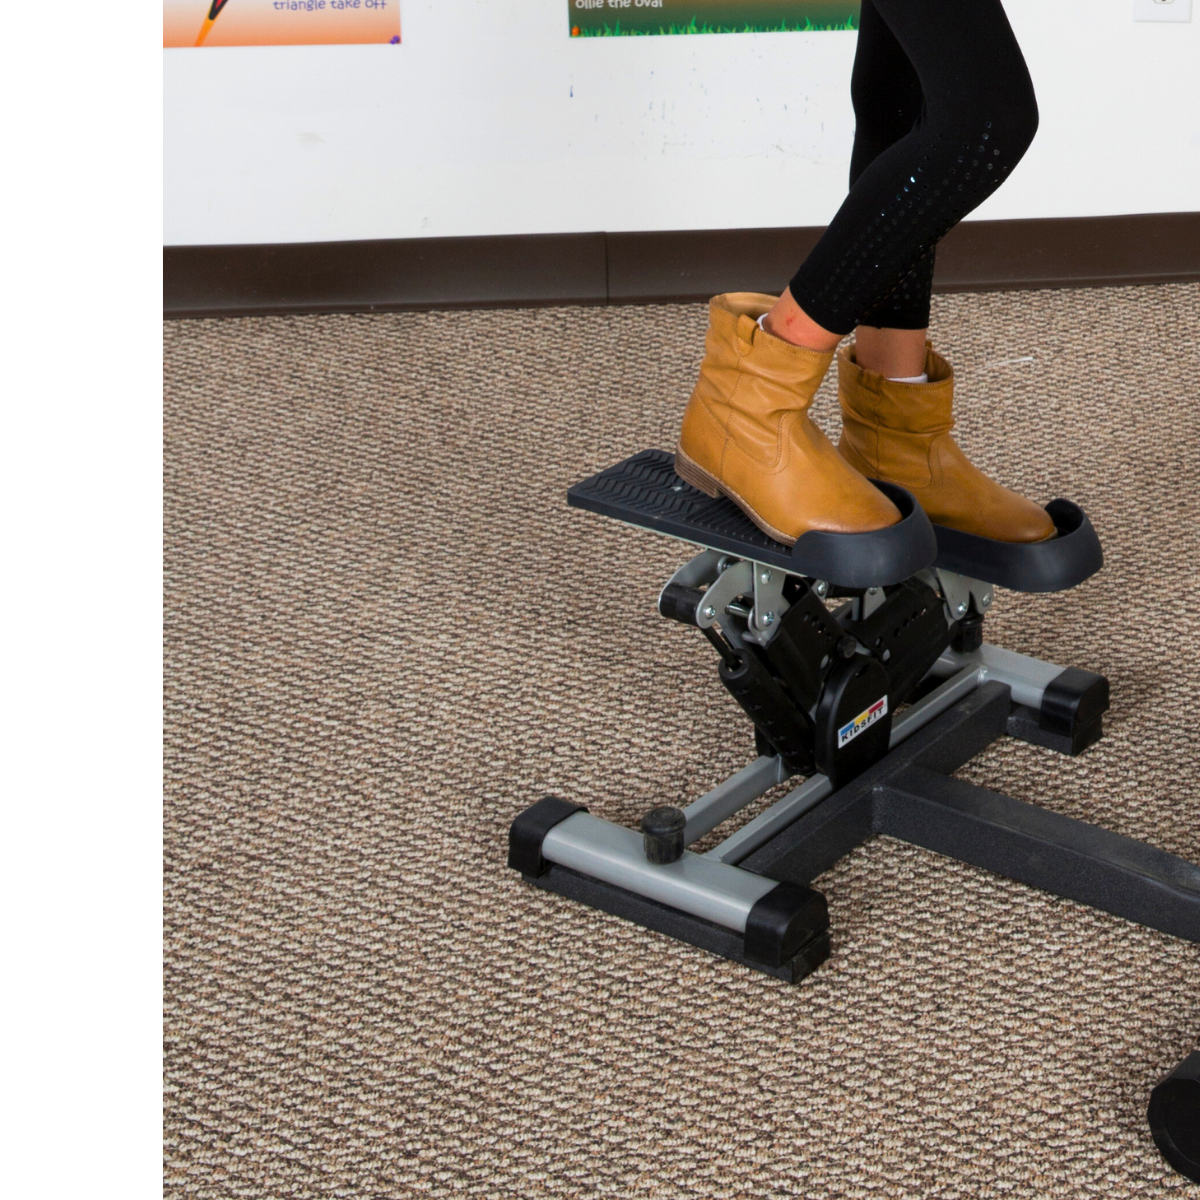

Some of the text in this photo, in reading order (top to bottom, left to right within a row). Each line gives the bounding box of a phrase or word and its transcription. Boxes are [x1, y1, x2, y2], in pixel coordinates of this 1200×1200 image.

[273, 0, 326, 11] triangle
[330, 0, 361, 9] take
[841, 707, 883, 742] KIDSFIT
